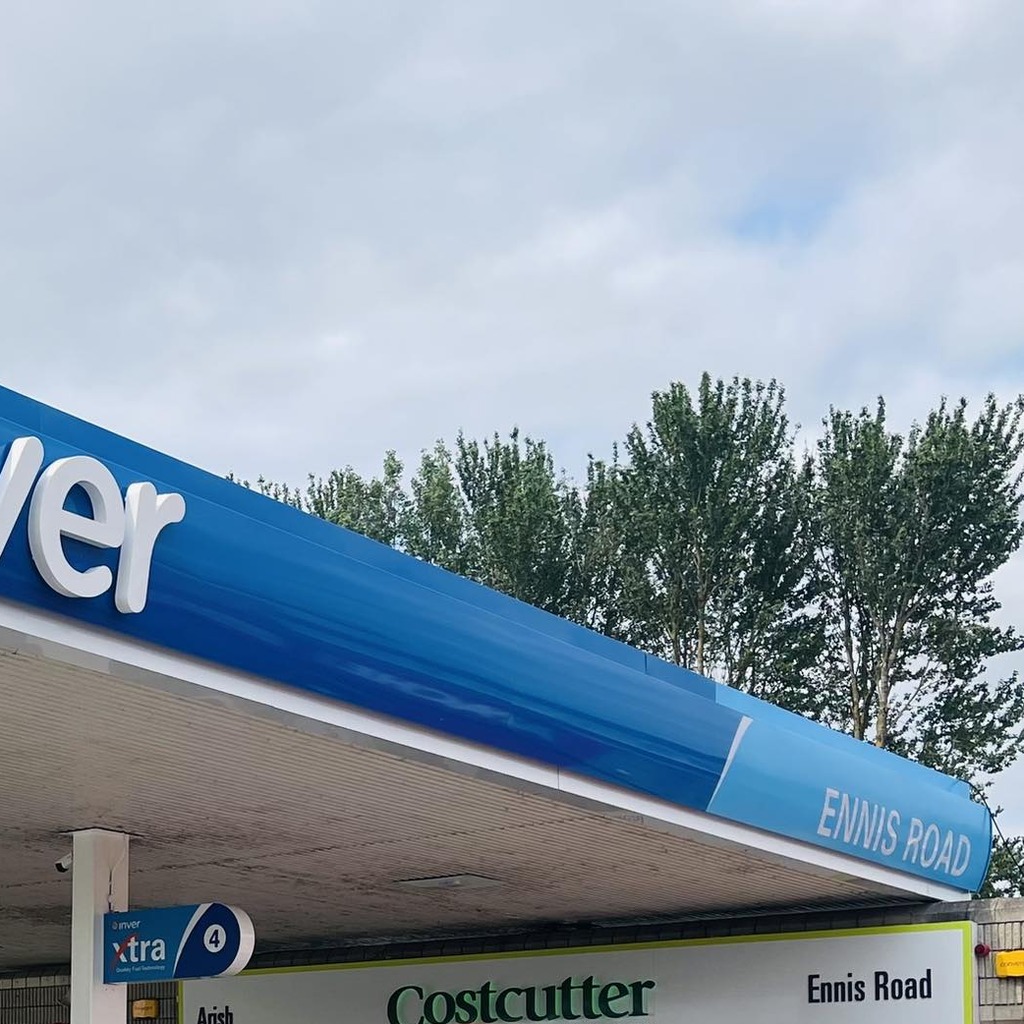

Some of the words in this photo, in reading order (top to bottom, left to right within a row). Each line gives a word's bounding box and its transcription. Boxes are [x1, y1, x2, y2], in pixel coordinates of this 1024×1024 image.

[817, 787, 901, 856] ENNIS
[902, 817, 972, 877] ROAD
[118, 920, 140, 930] inver
[208, 929, 220, 947] 4
[113, 935, 166, 963] xtra
[807, 972, 865, 1003] Ennis
[874, 969, 932, 1001] Road
